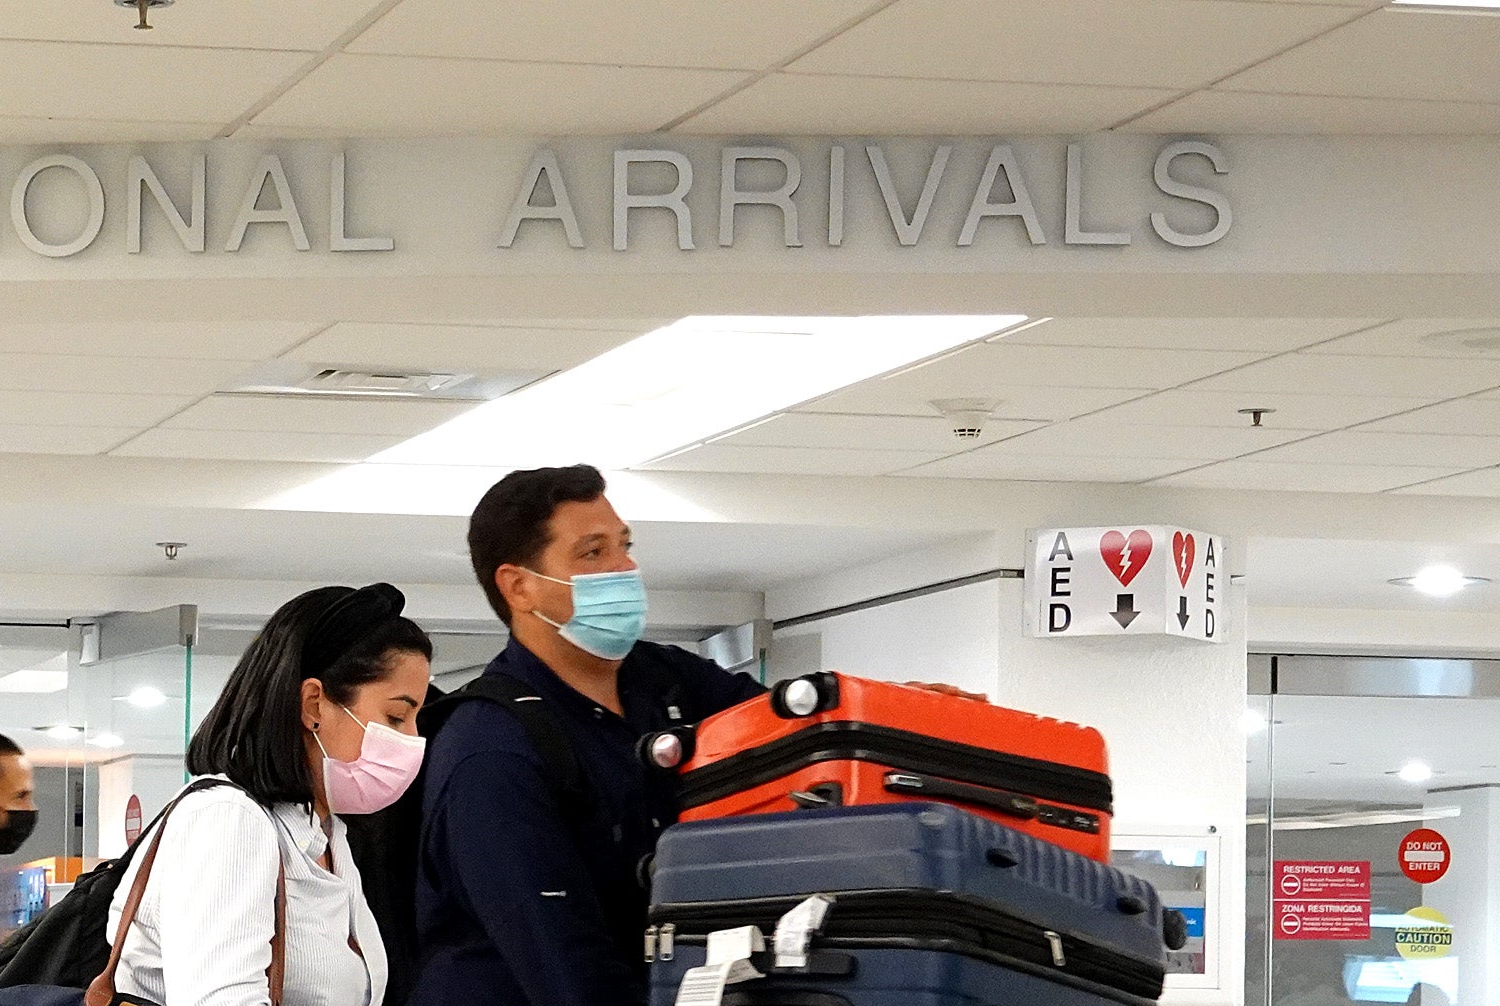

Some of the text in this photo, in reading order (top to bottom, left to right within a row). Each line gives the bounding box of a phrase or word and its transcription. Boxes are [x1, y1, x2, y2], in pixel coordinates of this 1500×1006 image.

[496, 139, 1233, 252] ARRIVALS
[1048, 531, 1074, 633] AED
[1205, 537, 1215, 638] AED
[1406, 841, 1443, 851] DO NOT
[1283, 865, 1361, 874] RESTRICTED AREA
[1408, 862, 1440, 871] ENTER
[1281, 904, 1363, 913] ZONA RESTRINGIDA
[1396, 932, 1451, 945] CAUTION
[1410, 944, 1437, 953] DOOR
